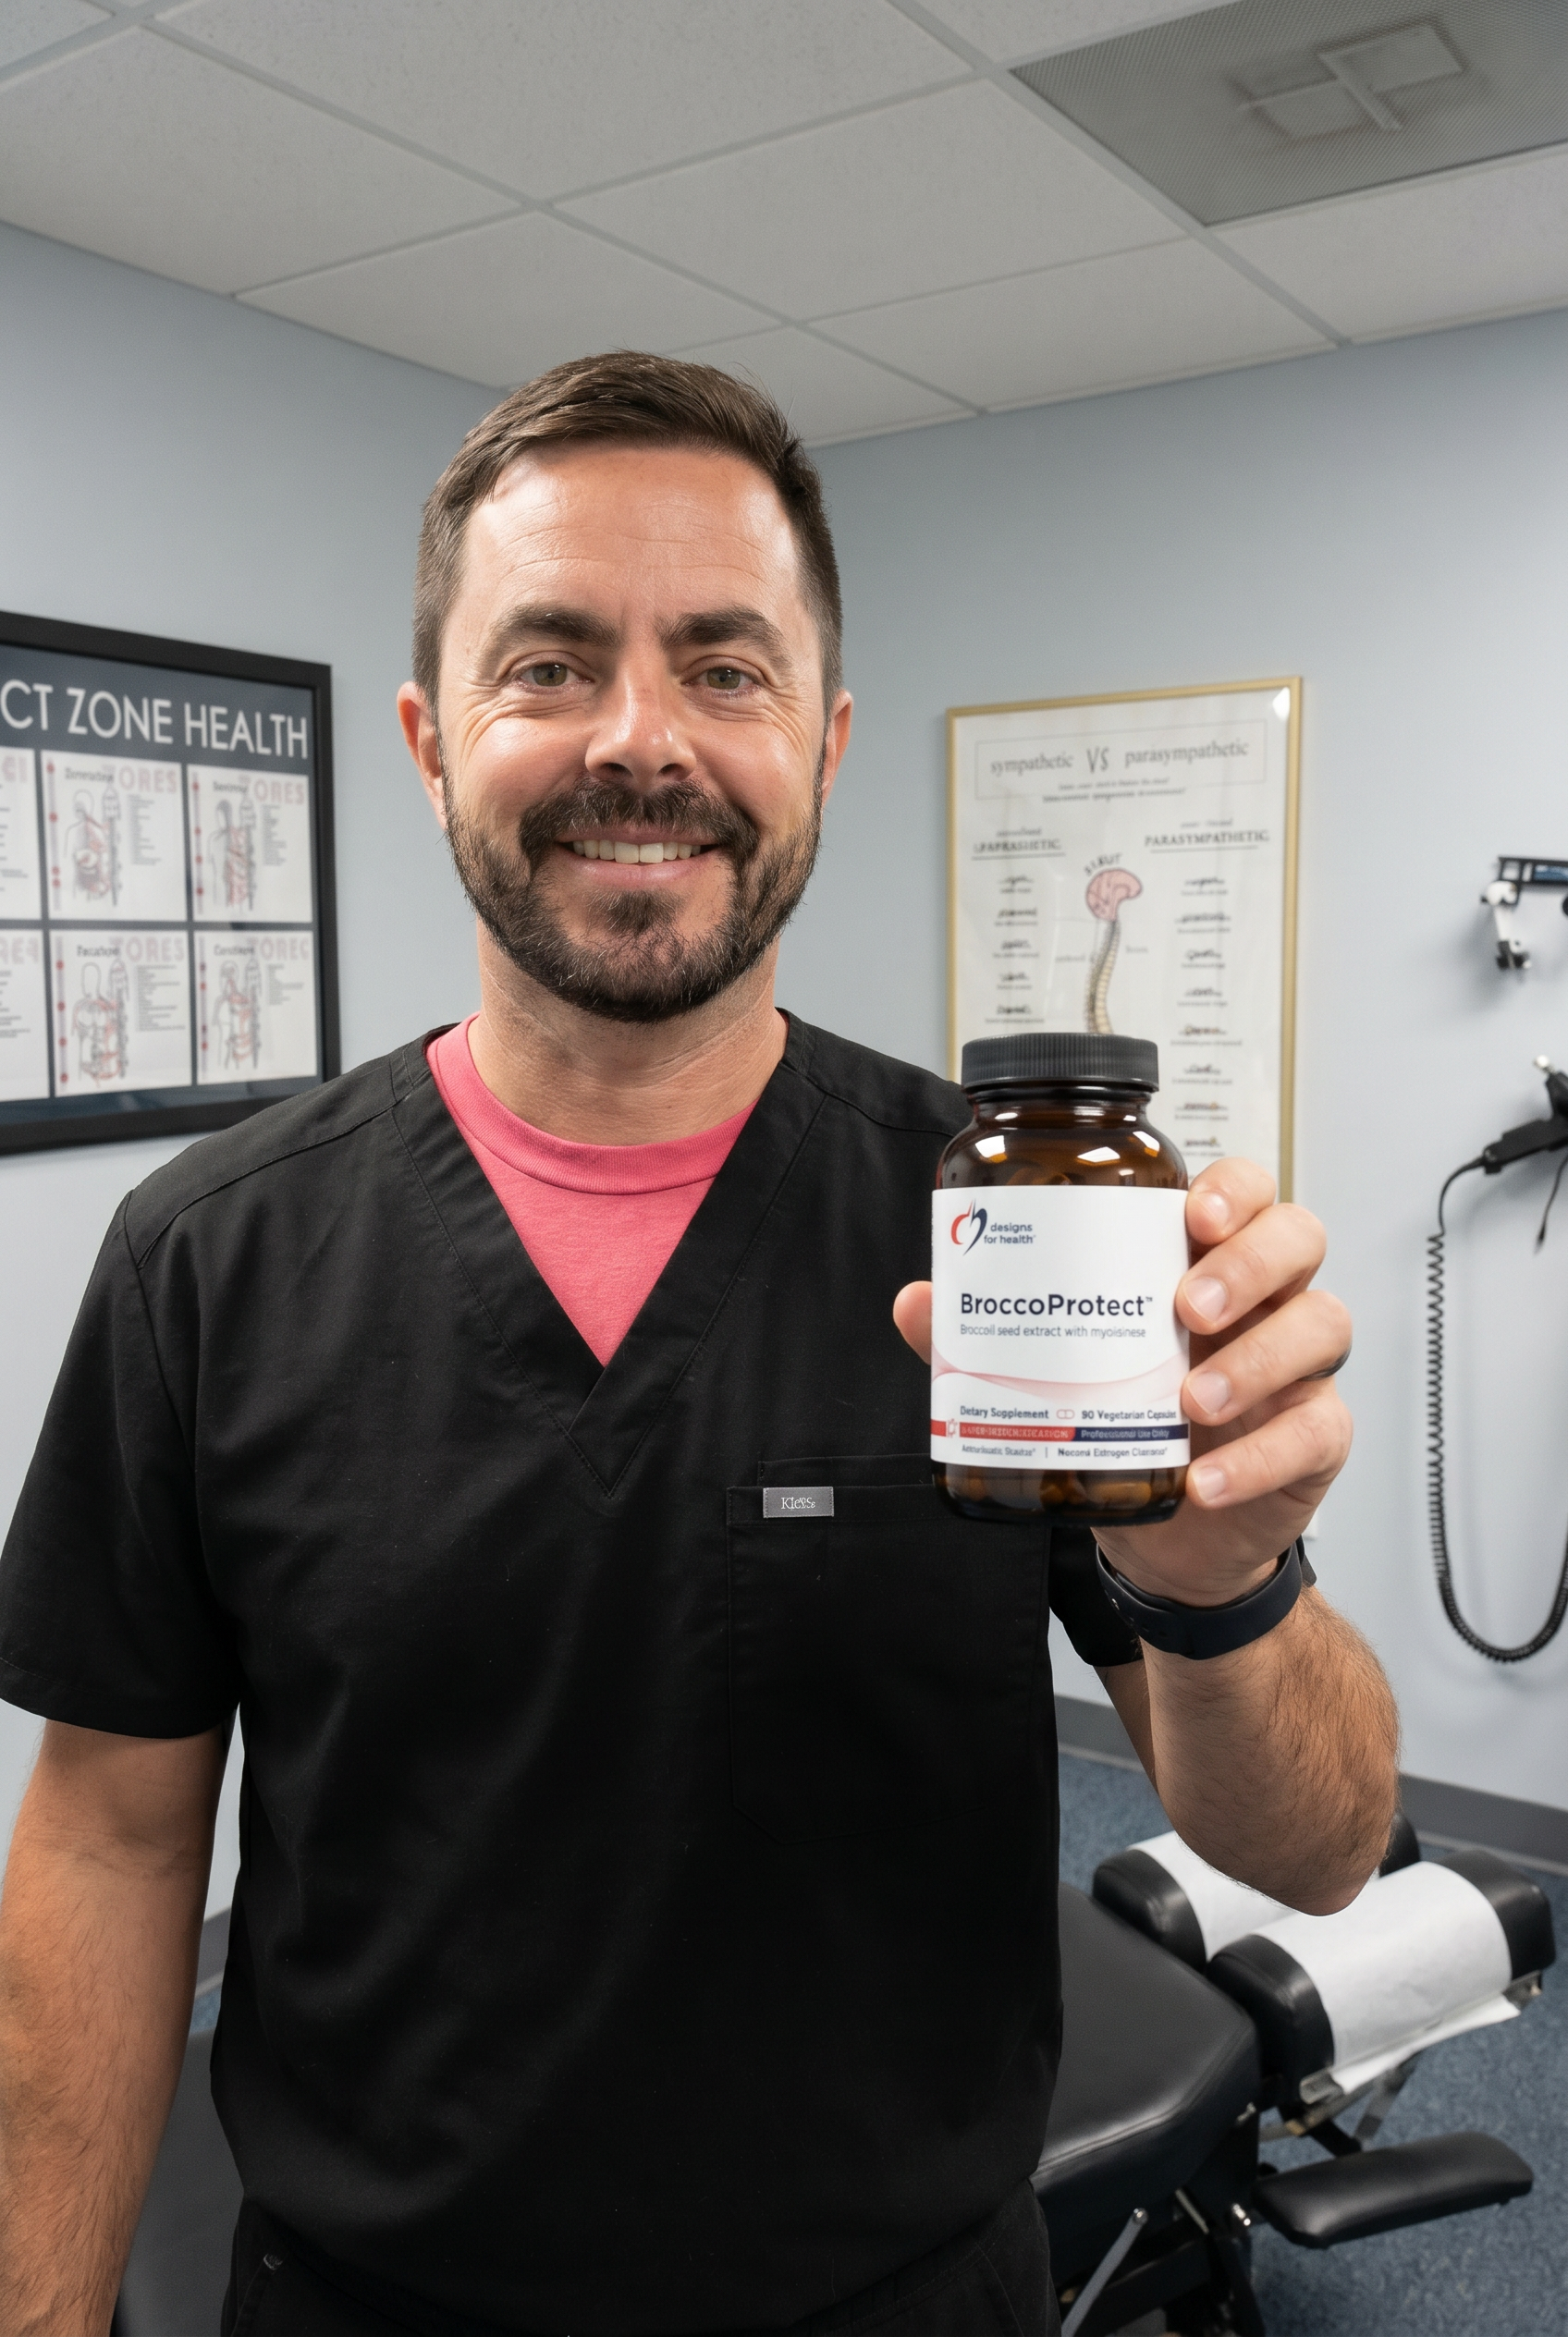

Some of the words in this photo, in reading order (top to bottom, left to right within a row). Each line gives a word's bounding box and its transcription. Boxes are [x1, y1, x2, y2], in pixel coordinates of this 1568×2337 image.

[66, 687, 174, 745] ZONE
[184, 702, 309, 761] HEALTH
[989, 752, 1074, 777] sympathetic
[1086, 745, 1109, 774] VS
[1124, 738, 1251, 769] parasympathetic
[990, 1222, 1033, 1234] designs
[984, 1234, 997, 1244] for
[999, 1234, 1033, 1244] health
[998, 1325, 1021, 1337] seed
[1023, 1325, 1061, 1338] extract
[1064, 1326, 1088, 1338] with
